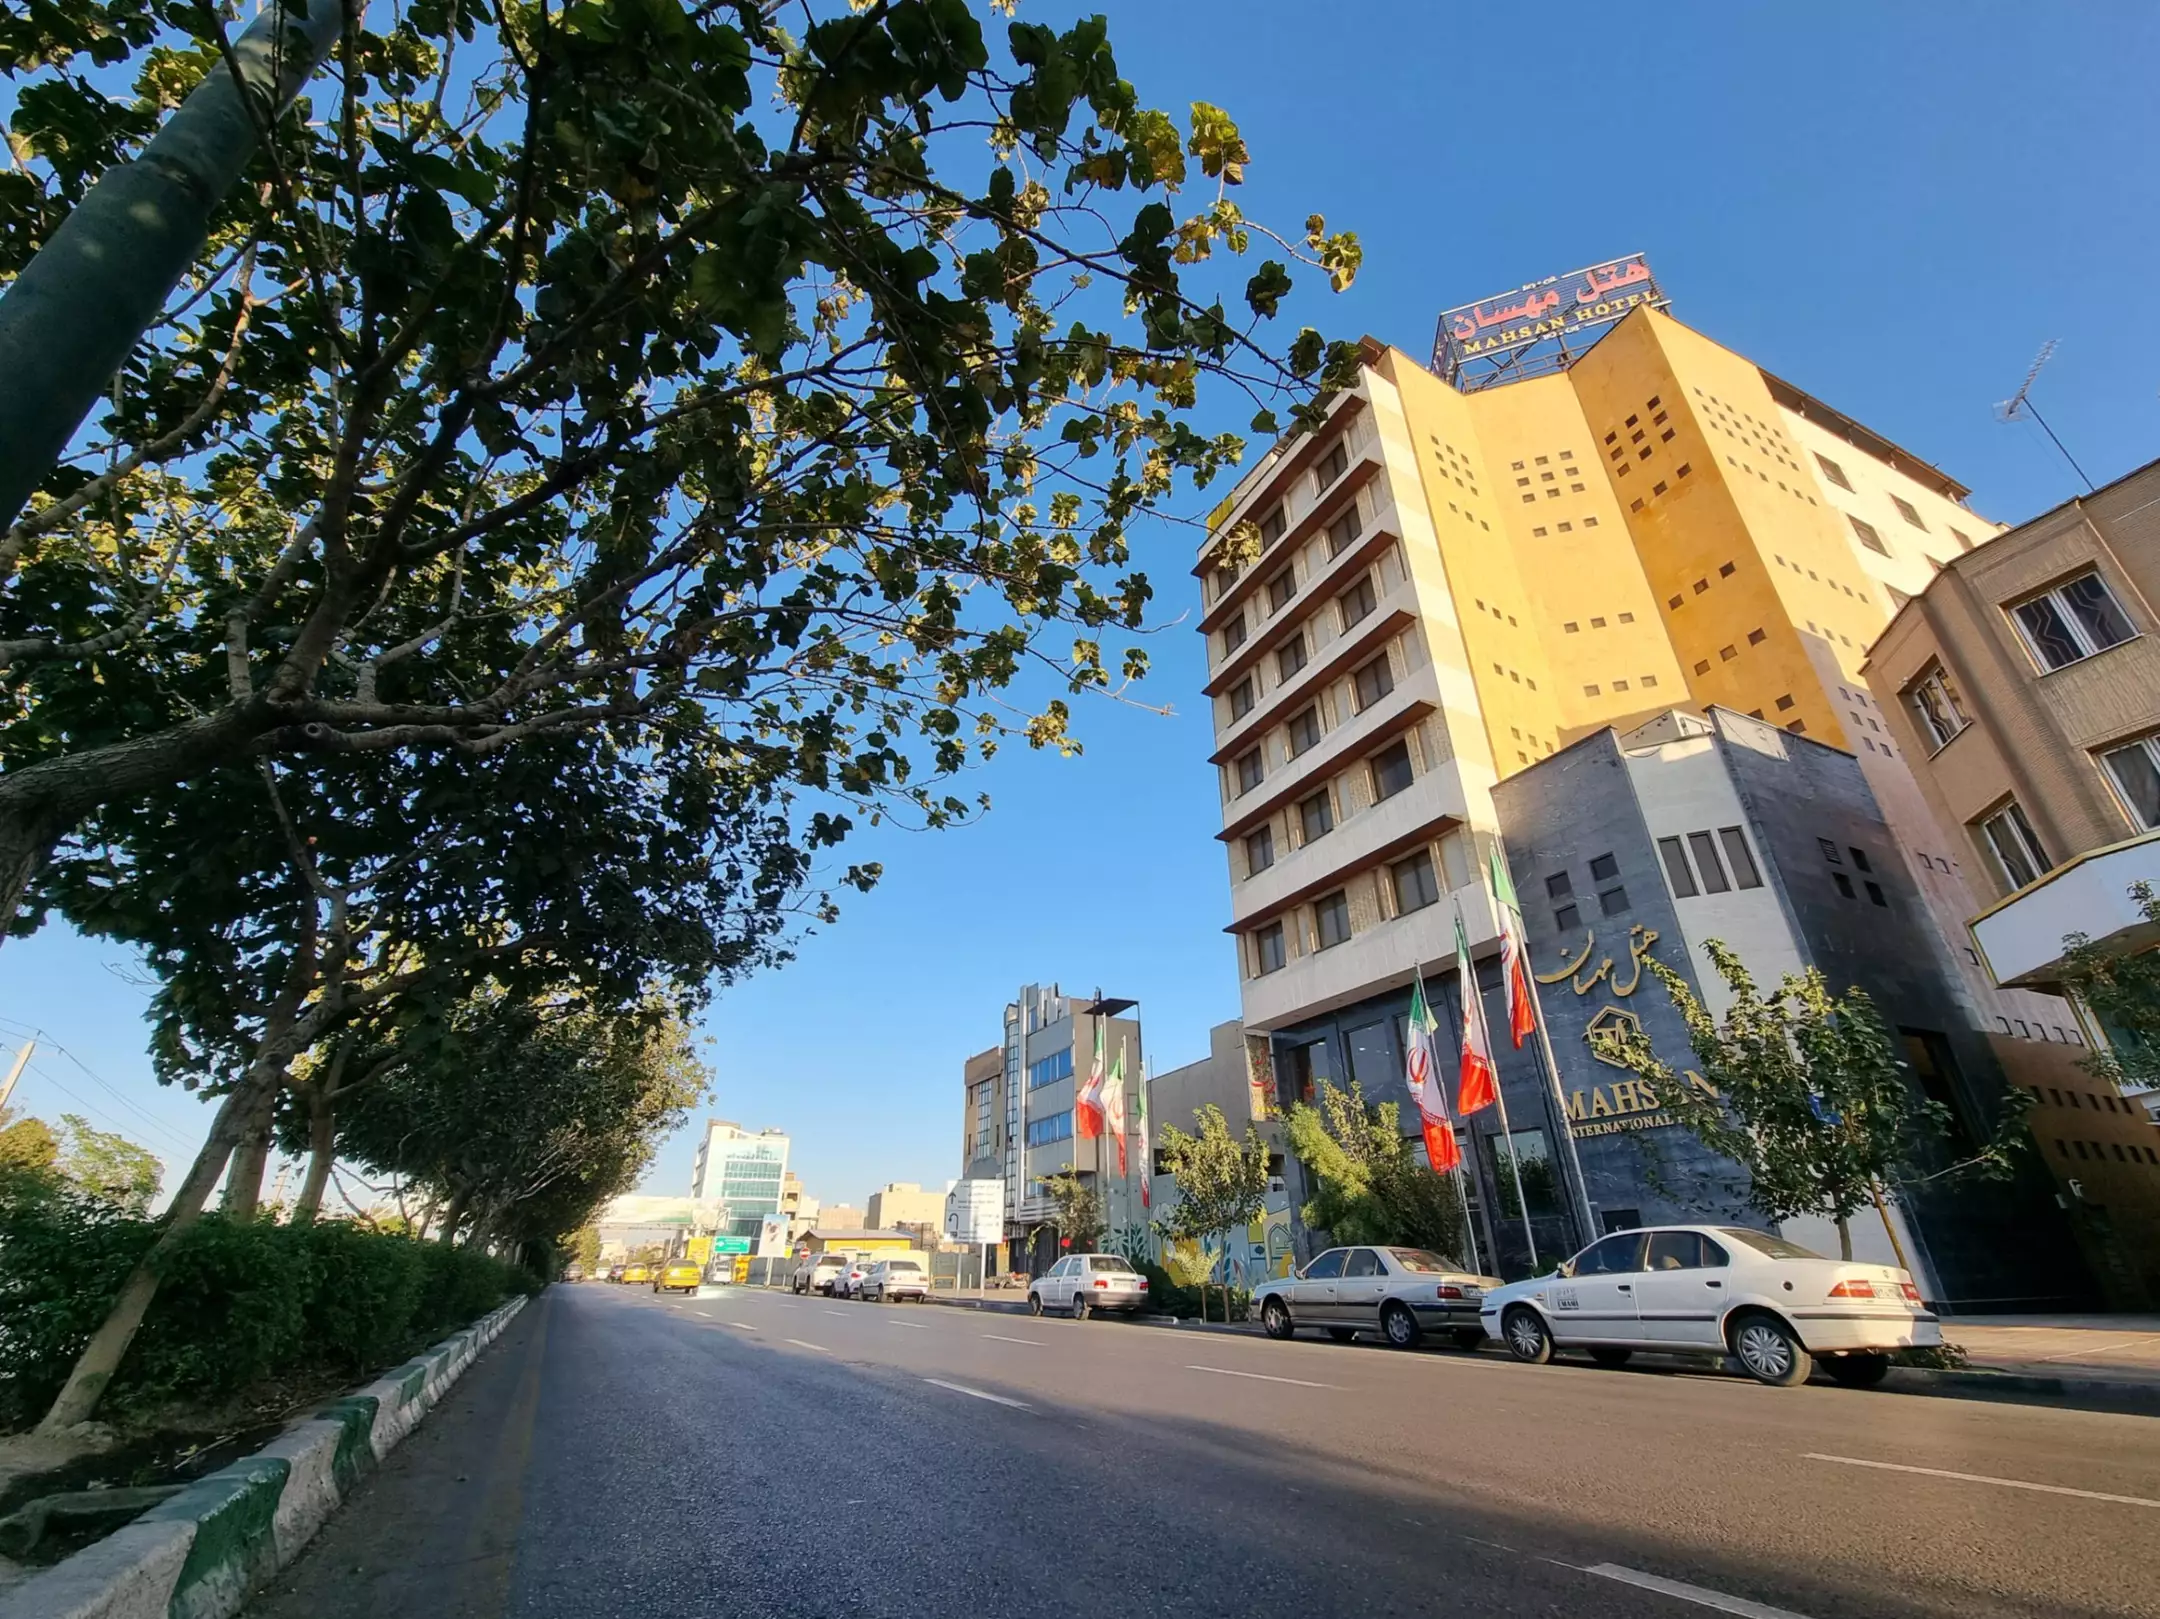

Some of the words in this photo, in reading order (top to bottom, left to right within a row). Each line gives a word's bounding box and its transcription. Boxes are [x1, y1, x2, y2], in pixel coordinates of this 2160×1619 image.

[1576, 262, 1650, 304] هتل
[1453, 288, 1560, 341] مهسان
[1463, 316, 1566, 355] MAHSAN
[1574, 290, 1660, 322] HOTEL
